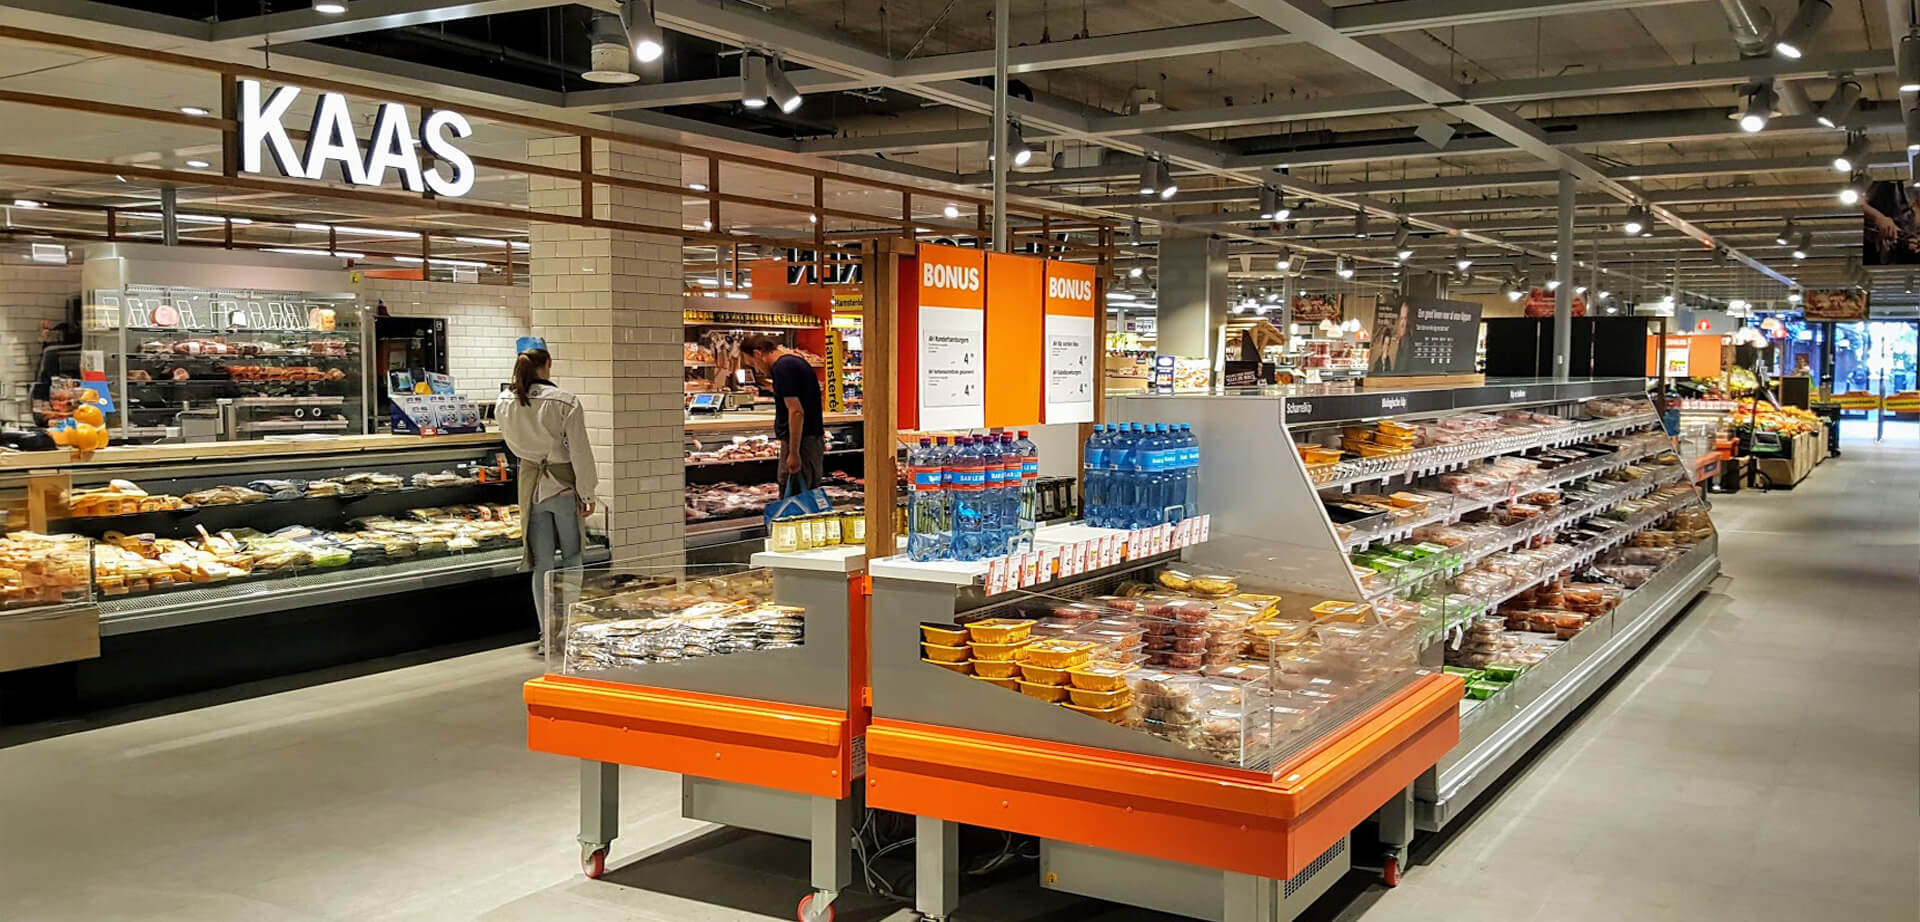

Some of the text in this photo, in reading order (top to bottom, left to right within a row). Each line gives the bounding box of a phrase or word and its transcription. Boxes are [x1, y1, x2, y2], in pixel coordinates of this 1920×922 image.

[237, 79, 475, 197] KAAS
[923, 262, 979, 291] BONUS
[1048, 276, 1092, 301] BONUS
